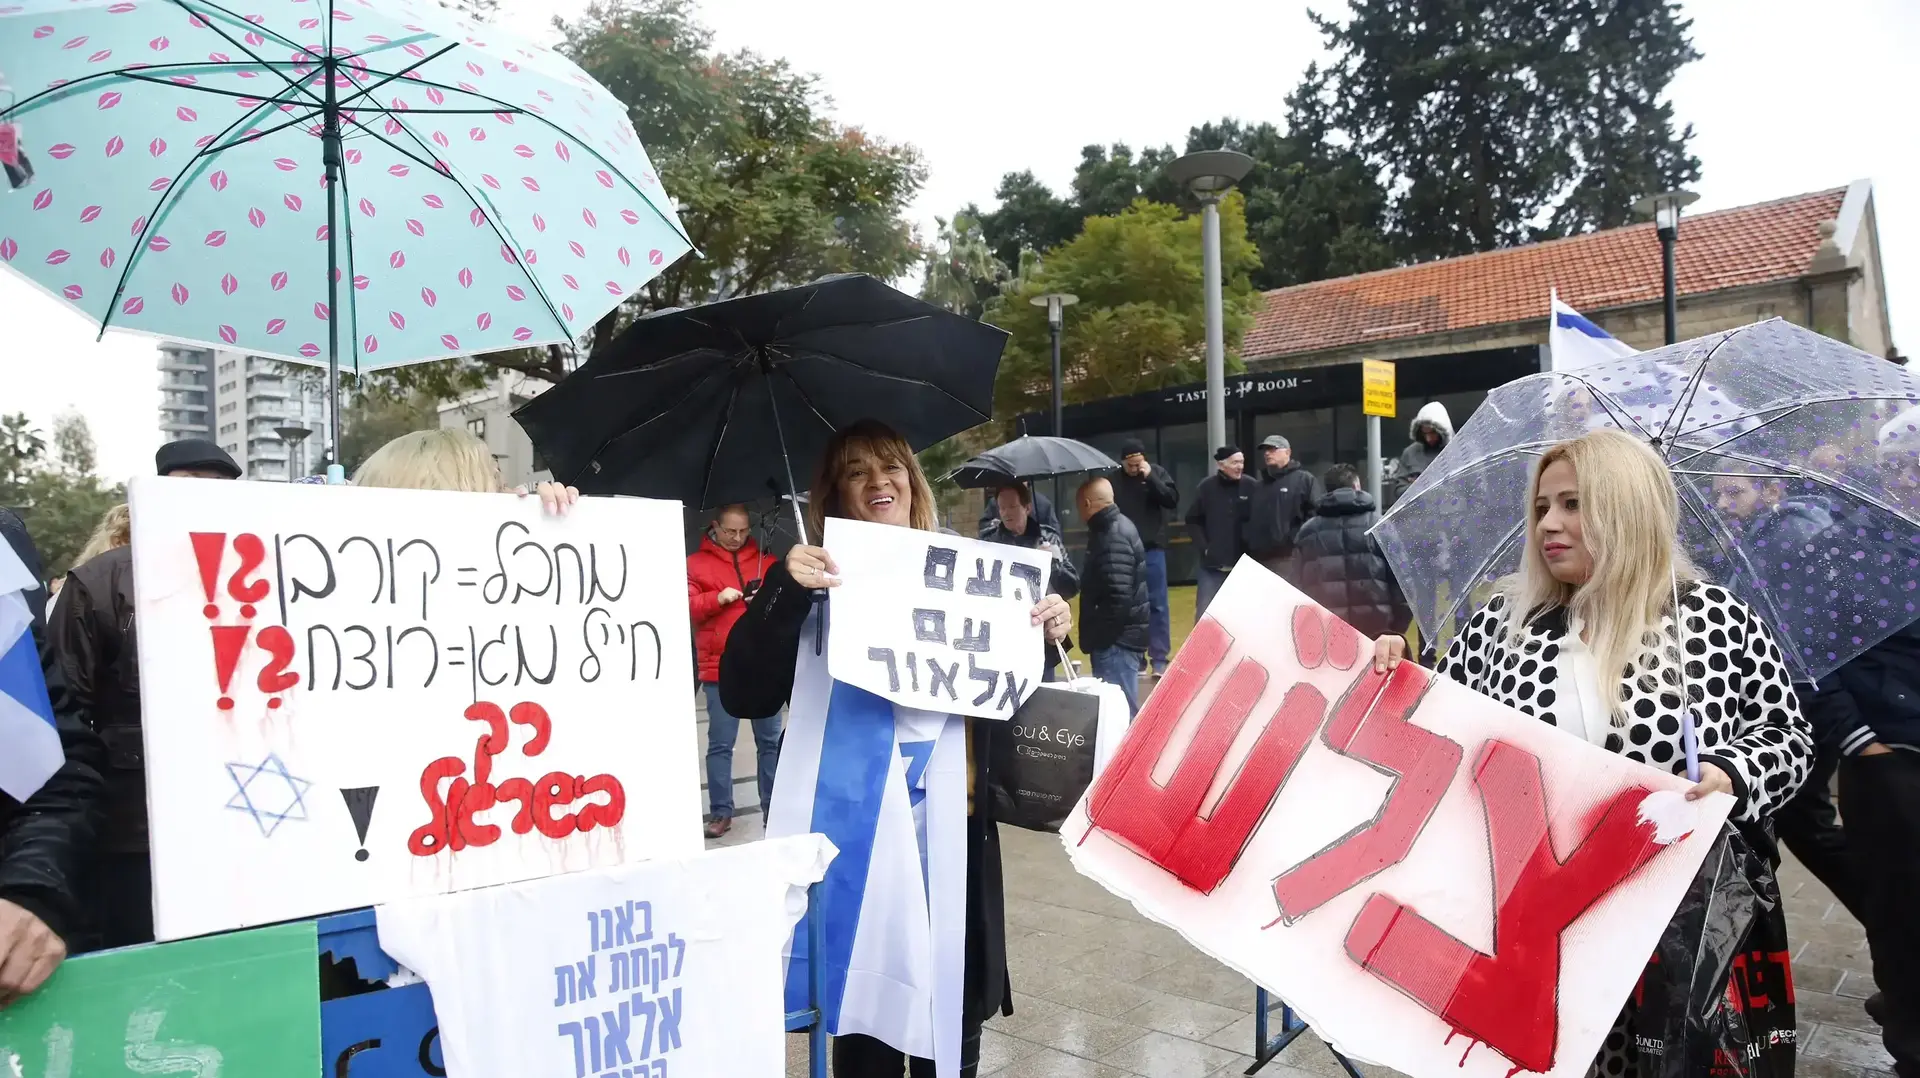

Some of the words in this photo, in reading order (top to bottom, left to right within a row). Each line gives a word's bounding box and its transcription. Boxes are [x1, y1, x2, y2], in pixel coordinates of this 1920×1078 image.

[1177, 387, 1231, 403] TASTG
[1257, 378, 1298, 392] ROOM
[924, 545, 1042, 604] העם
[579, 607, 662, 683] חייל
[912, 607, 991, 653] עם
[867, 645, 1028, 713] אלאור
[464, 700, 552, 786] רק
[1012, 725, 1036, 739] ou
[1038, 725, 1052, 742] &
[1056, 728, 1085, 748] Eye
[407, 756, 626, 856] בישראל
[587, 899, 654, 953] באנו
[553, 954, 598, 1008] את
[608, 932, 687, 995] לקחת
[557, 986, 683, 1078] אלאור
